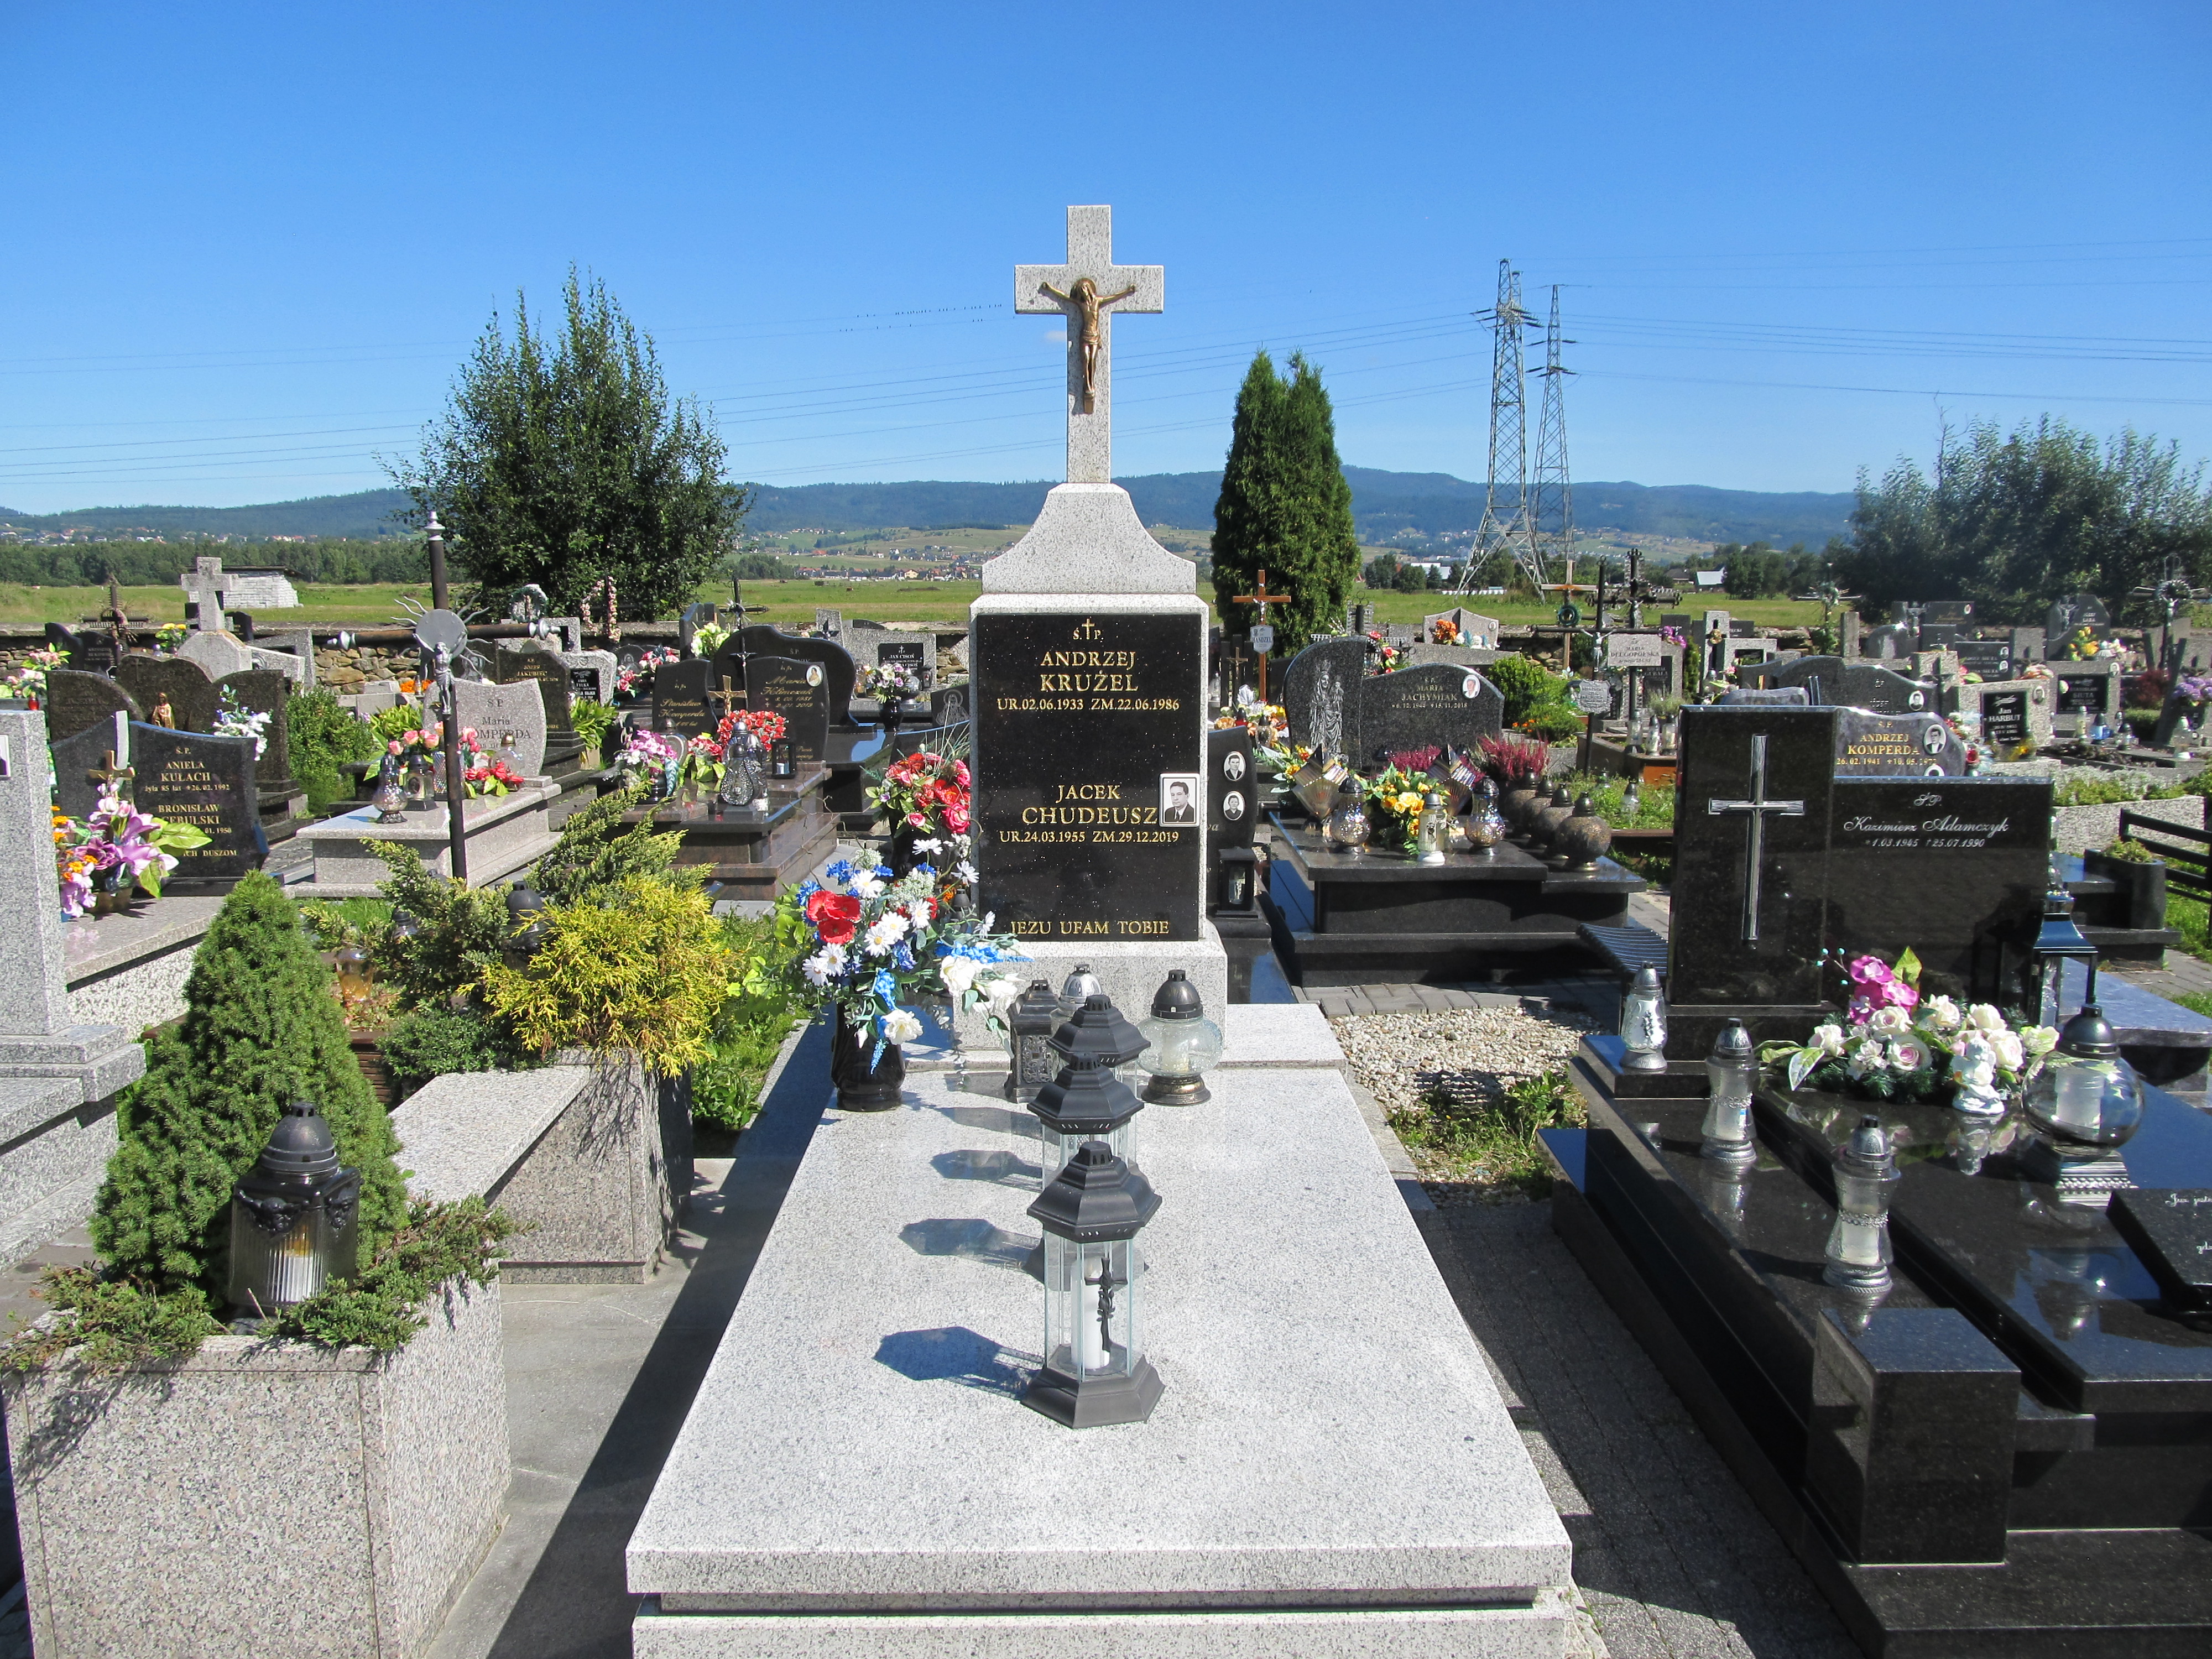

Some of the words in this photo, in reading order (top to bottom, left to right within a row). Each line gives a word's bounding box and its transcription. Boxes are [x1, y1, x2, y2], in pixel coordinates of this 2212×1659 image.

[1040, 651, 1136, 670] ANDRZEJ
[1040, 670, 1139, 692] KRUŻEL
[997, 698, 1084, 710] UR.02.06.1933
[1091, 698, 1180, 711] ZM.22.06.1986
[1860, 734, 1910, 742] ANDRZEJ
[1848, 745, 1920, 755] KOMPERDA
[166, 761, 205, 769] ANIELA
[1055, 784, 1121, 804] JACEK
[1022, 806, 1159, 825] CHUDEUSZ
[1843, 816, 1918, 831] Kazimierz
[1922, 814, 2009, 838] Adamczyk
[999, 830, 1085, 843] UR.24.03.1955
[1092, 830, 1180, 843] ZM.29.12.2019
[1060, 920, 1109, 934] UFAM
[1117, 921, 1170, 934] TOBIE
